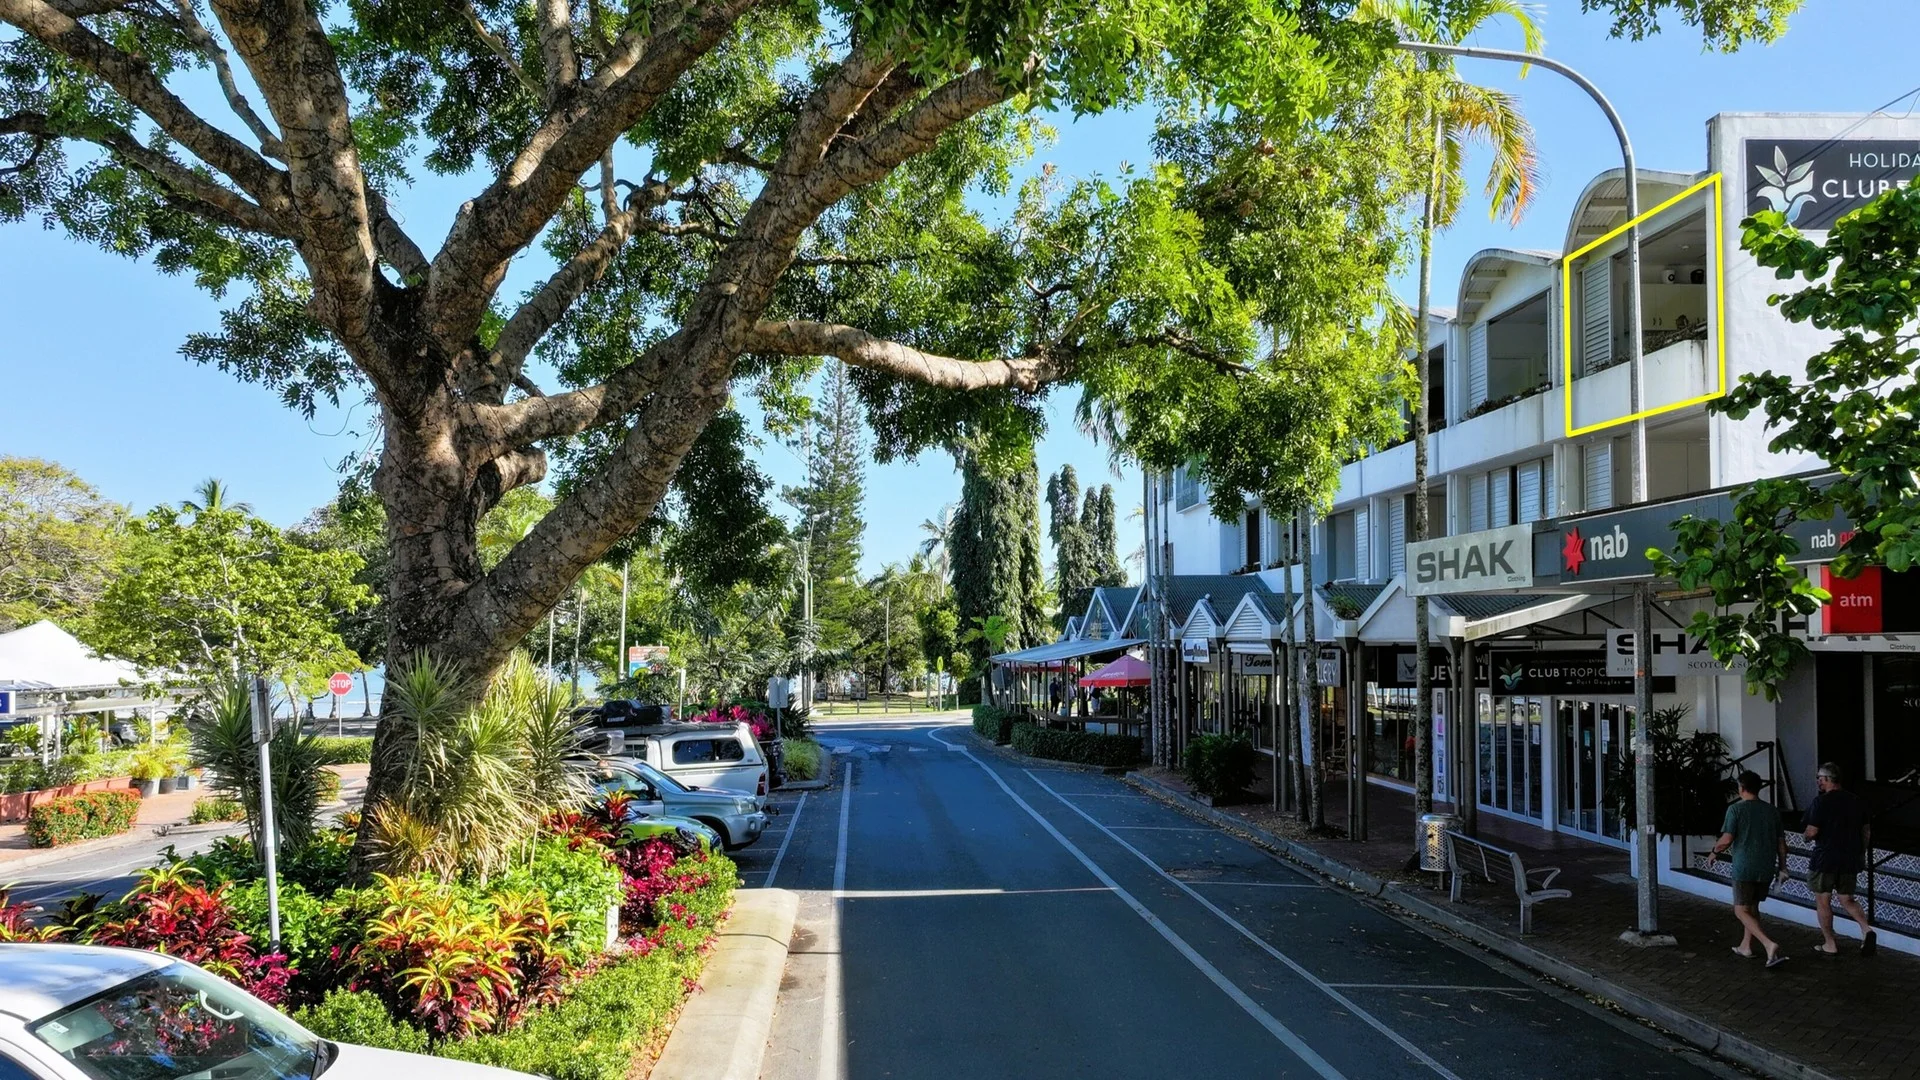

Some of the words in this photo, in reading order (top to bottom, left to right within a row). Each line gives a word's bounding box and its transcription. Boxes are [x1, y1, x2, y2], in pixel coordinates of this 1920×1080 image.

[1590, 525, 1628, 561] nab
[1811, 528, 1836, 549] nab
[1416, 539, 1515, 583] SHAK
[1839, 593, 1873, 607] atm
[1616, 633, 1710, 655] SHA
[1889, 643, 1916, 651] Clothing
[1528, 667, 1561, 678] CLUB
[330, 679, 352, 689] STOP
